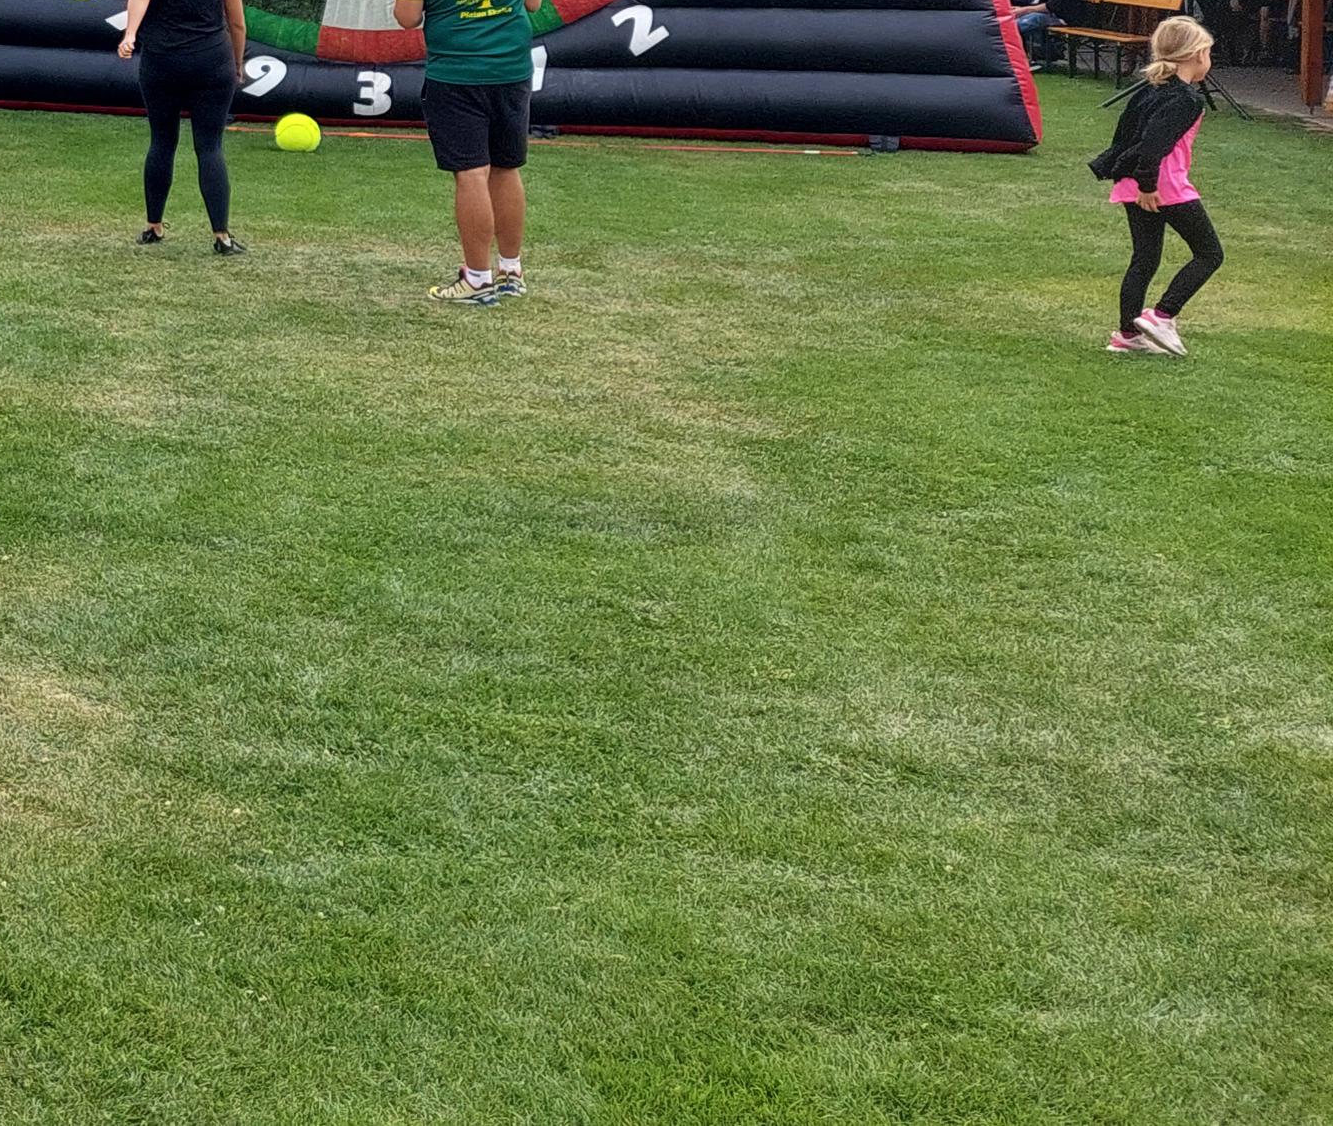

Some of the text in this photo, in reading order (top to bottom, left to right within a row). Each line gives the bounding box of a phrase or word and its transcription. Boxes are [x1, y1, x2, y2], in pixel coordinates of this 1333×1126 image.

[610, 4, 670, 57] 2
[241, 54, 288, 97] 9
[353, 70, 393, 116] 3
